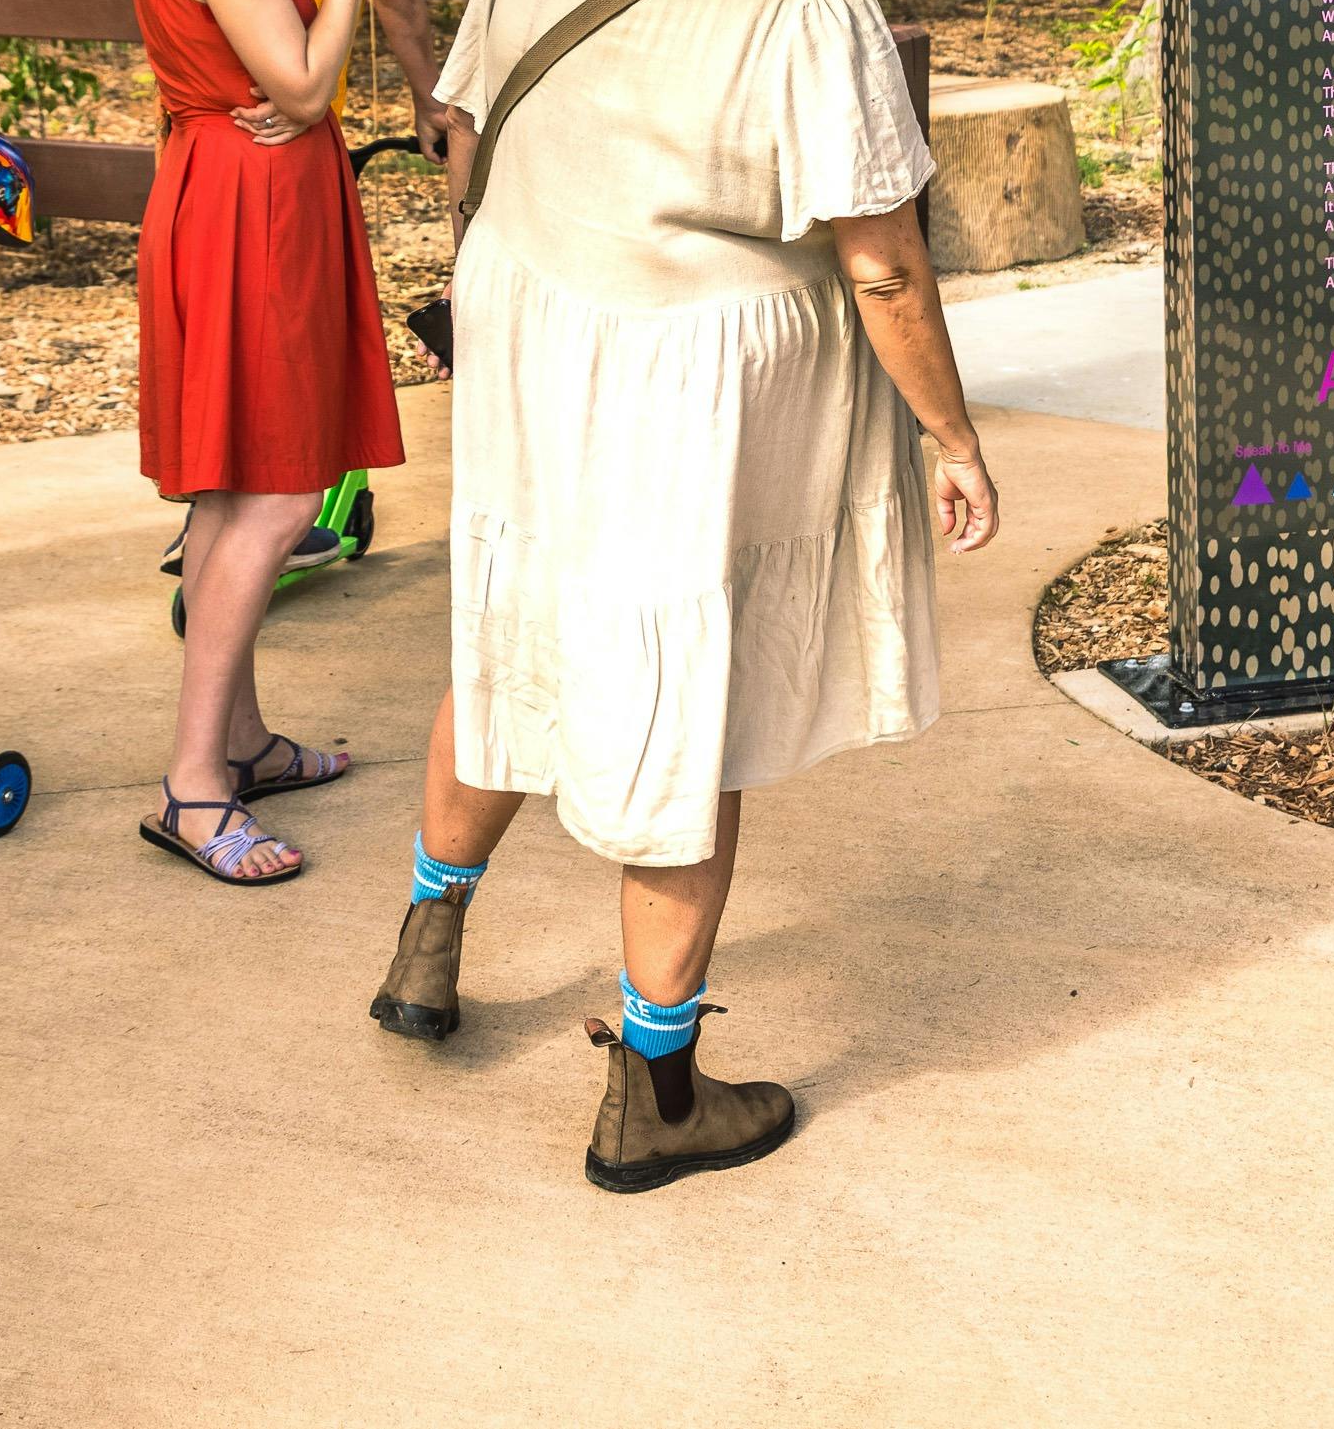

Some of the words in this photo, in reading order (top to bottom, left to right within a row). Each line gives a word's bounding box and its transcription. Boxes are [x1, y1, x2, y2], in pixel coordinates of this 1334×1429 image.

[1322, 67, 1332, 79] A
[1323, 124, 1332, 136] A
[1324, 181, 1333, 193] A
[1324, 219, 1334, 231] A
[1325, 276, 1334, 288] A
